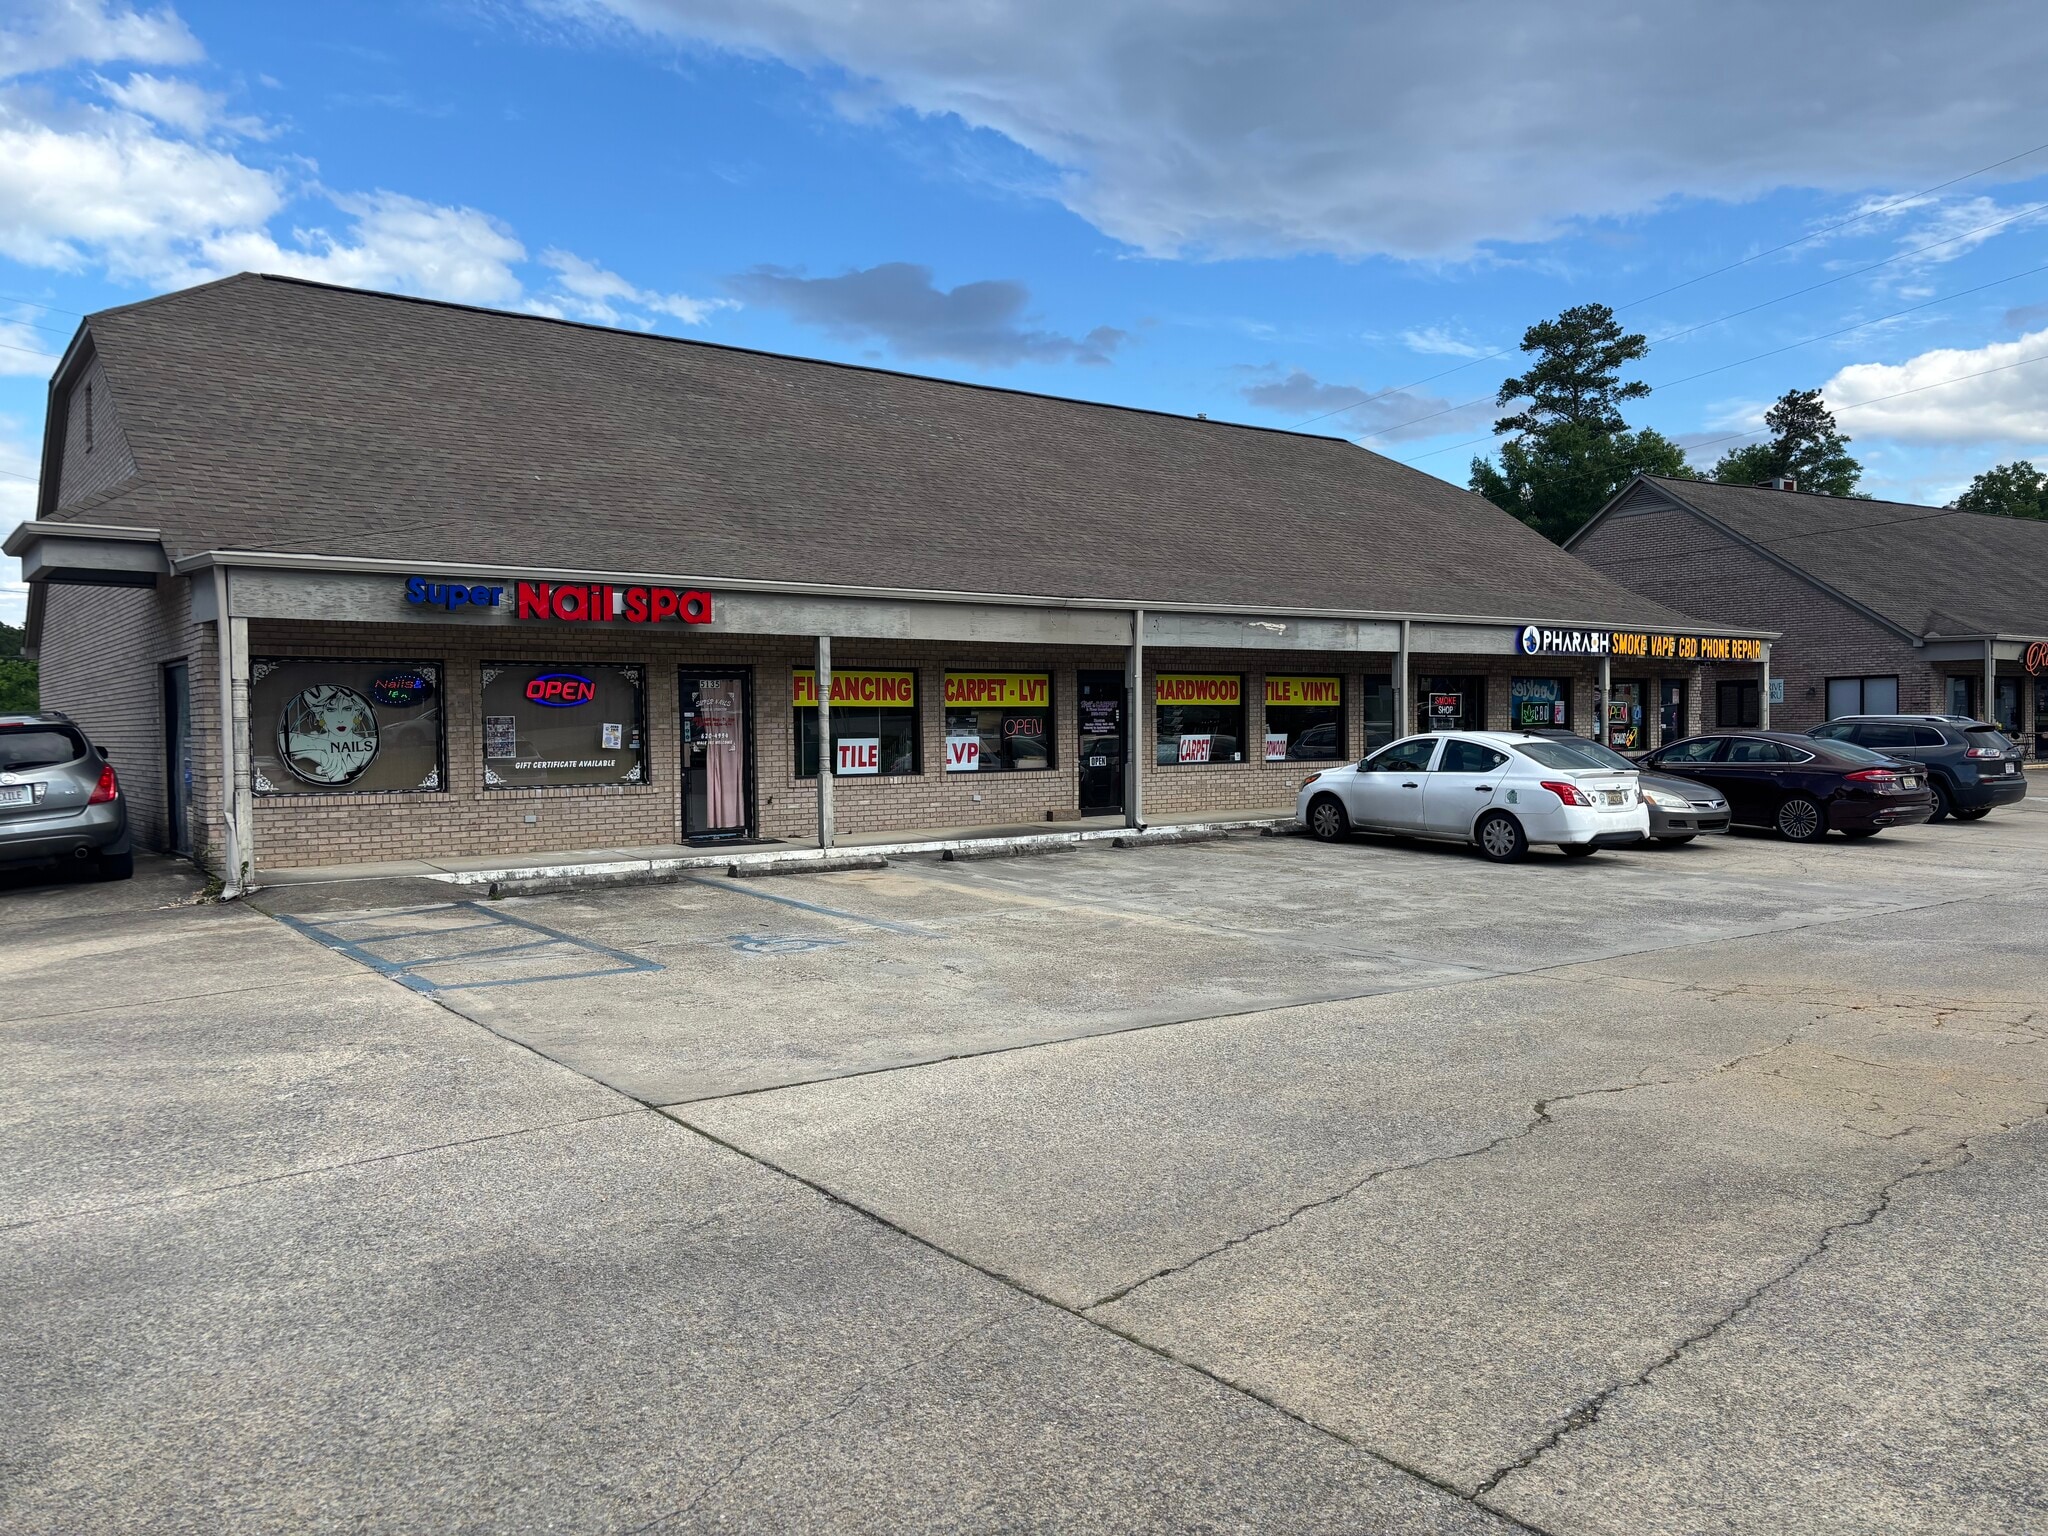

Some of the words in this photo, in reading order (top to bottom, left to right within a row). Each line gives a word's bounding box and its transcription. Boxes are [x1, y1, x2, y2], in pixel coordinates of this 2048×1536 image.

[406, 576, 503, 610] Super
[516, 581, 614, 620] Nail
[623, 586, 713, 625] spa
[1543, 630, 1609, 653] PHARAOH
[1612, 632, 1647, 656] SMOKE
[1651, 635, 1675, 657] VAPE
[1679, 637, 1697, 658] CBD
[1701, 637, 1730, 659] PHONE
[1732, 639, 1762, 660] REPAIR
[526, 680, 597, 700] OPEN
[945, 678, 1007, 702] CARPET
[1019, 679, 1047, 702] LVT
[1156, 680, 1239, 701] HARDWOOD
[1265, 681, 1291, 701] TILE
[1301, 682, 1339, 702] VINYL
[1434, 696, 1457, 705] SMOKE
[1438, 706, 1454, 714] SHOP
[1534, 706, 1549, 721] CBD
[1608, 705, 1627, 719] PEN
[1004, 719, 1043, 736] OPEN
[330, 740, 373, 754] NAILS
[838, 745, 878, 768] TILE
[1180, 739, 1210, 761] CARPET
[515, 761, 532, 769] GIFT
[532, 760, 578, 769] CERTIFICATE
[578, 759, 616, 767] AVAILABLE
